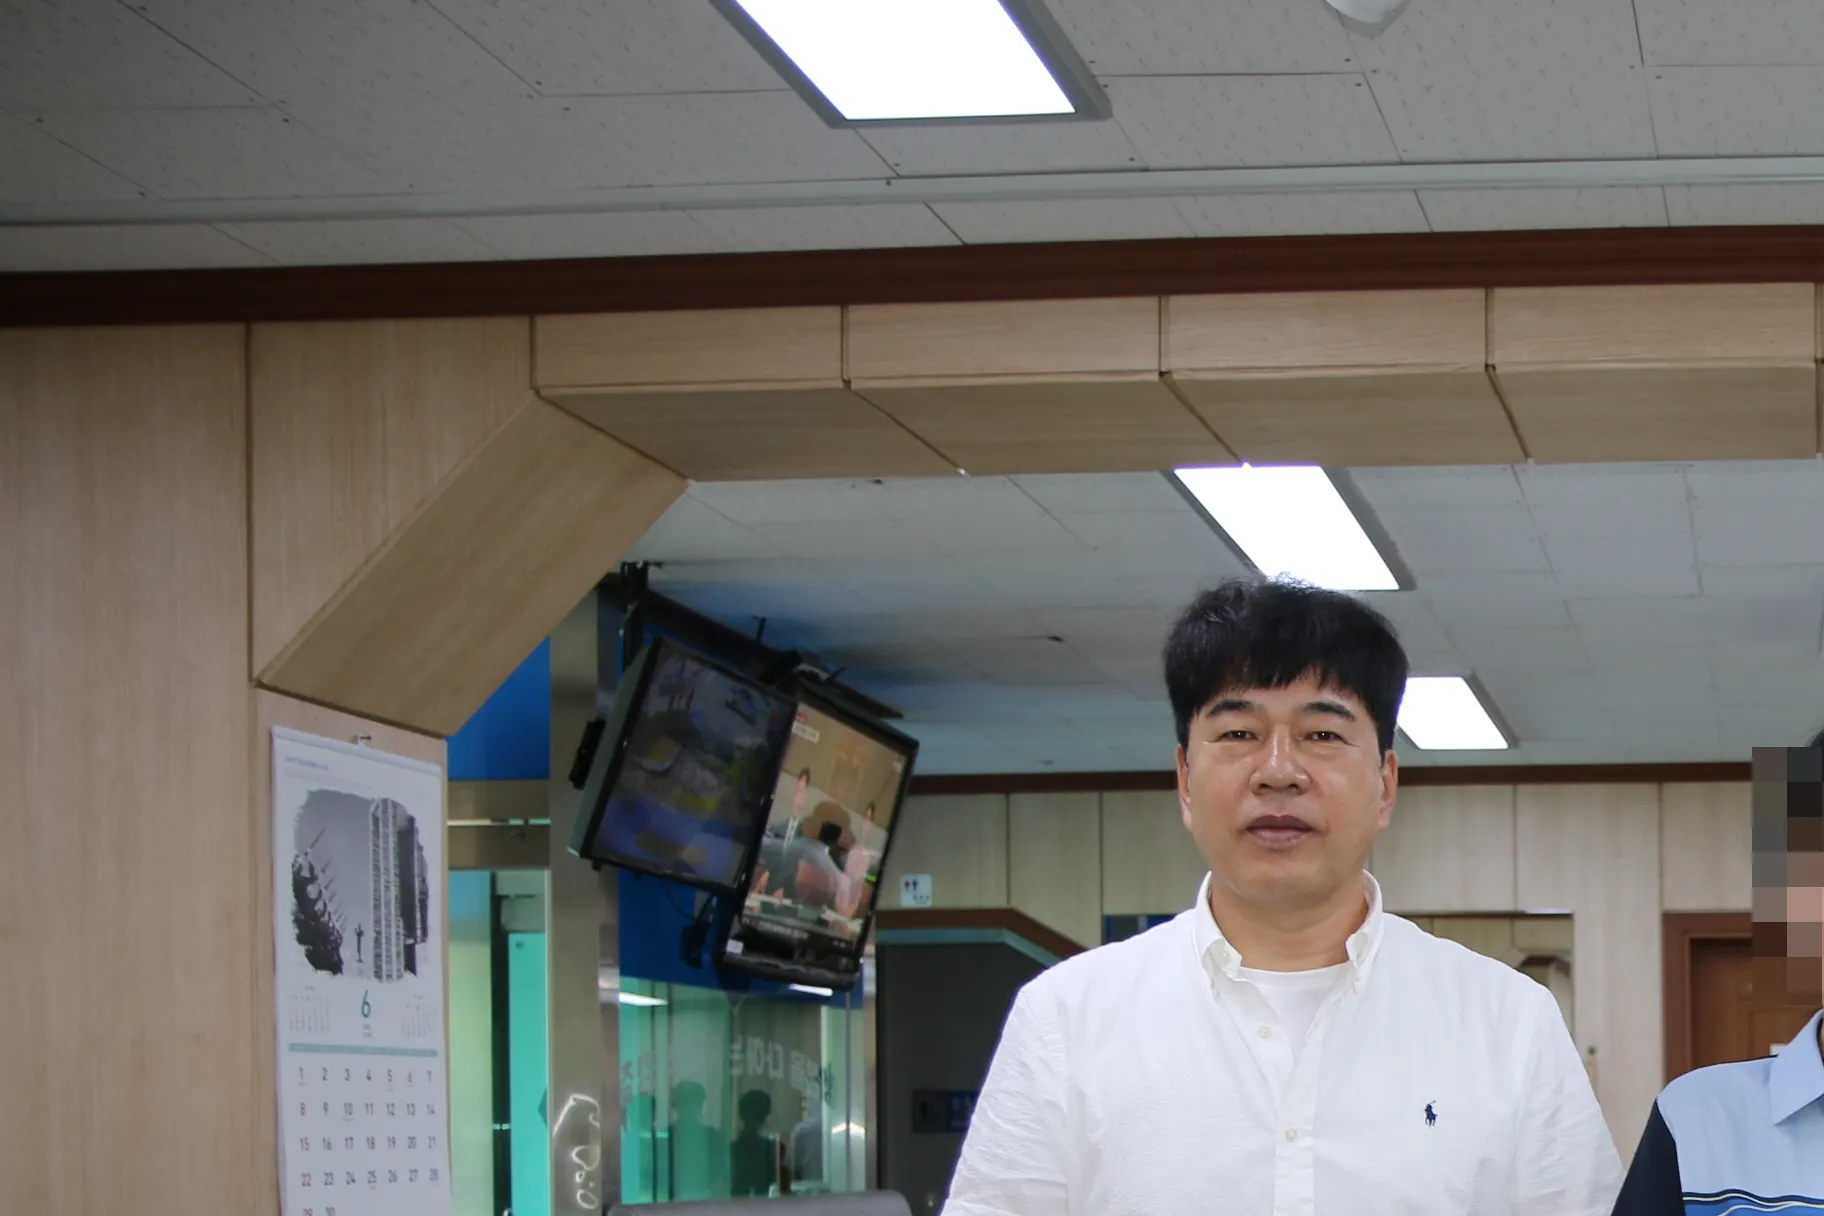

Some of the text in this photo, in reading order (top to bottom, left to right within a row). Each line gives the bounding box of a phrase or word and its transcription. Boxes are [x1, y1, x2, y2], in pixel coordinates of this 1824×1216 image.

[360, 988, 372, 1018] 6
[298, 1066, 304, 1081] 1
[321, 1066, 328, 1081] 2
[344, 1068, 350, 1082] 3
[366, 1069, 372, 1082] 4
[386, 1069, 393, 1082] 5
[426, 1070, 432, 1083] 7
[299, 1101, 436, 1117] 8 9 10 11 12 13 14
[299, 1135, 437, 1151] 15 16 17 18 19 20 21
[300, 1168, 439, 1187] 22 23 24 25 26 27 28
